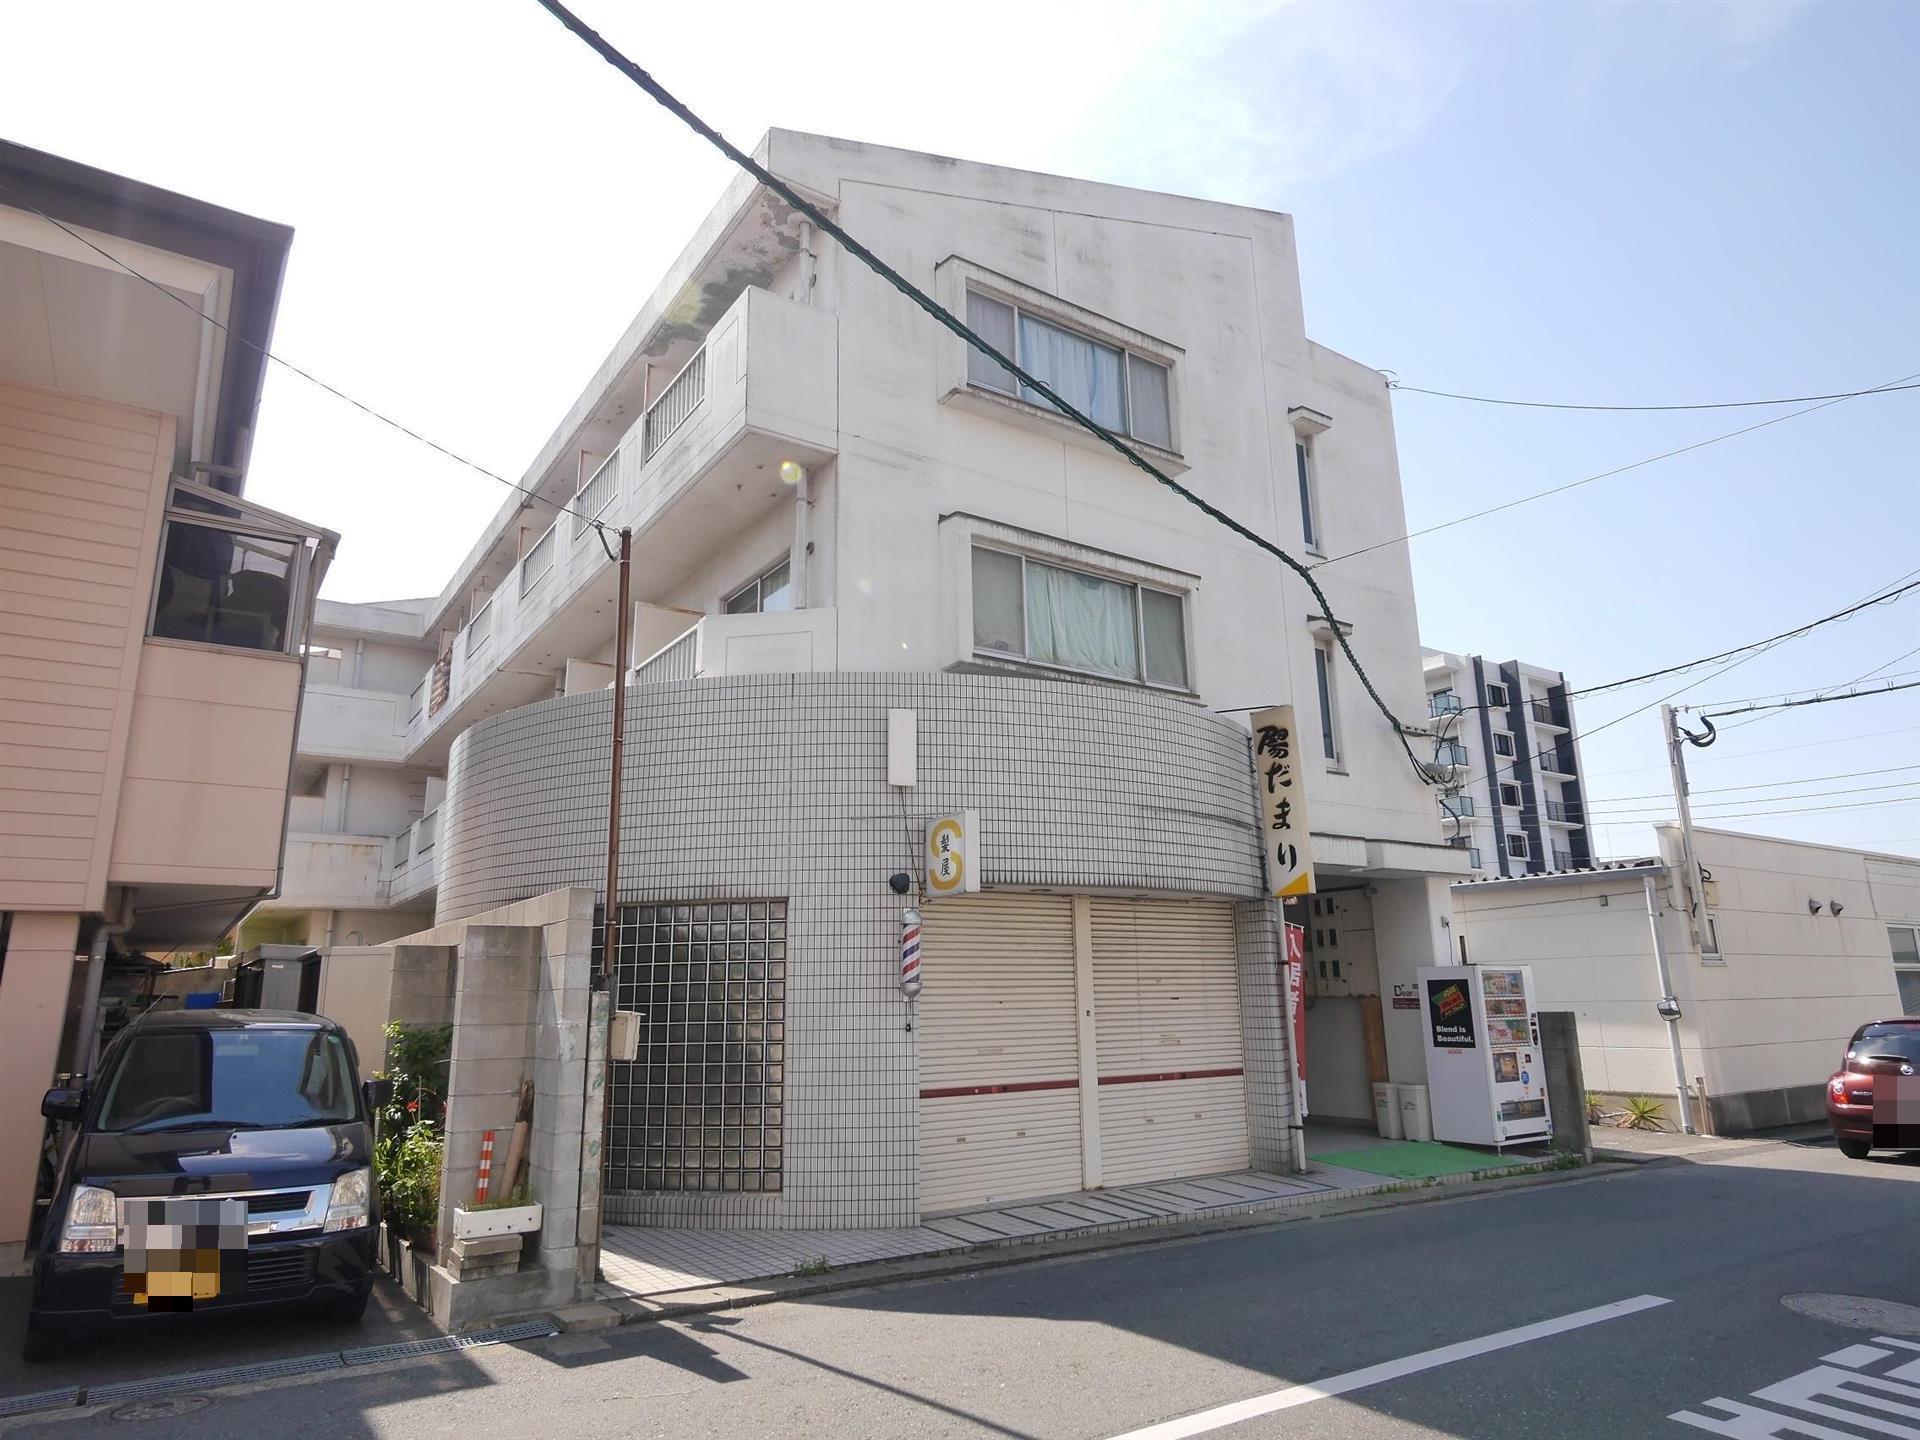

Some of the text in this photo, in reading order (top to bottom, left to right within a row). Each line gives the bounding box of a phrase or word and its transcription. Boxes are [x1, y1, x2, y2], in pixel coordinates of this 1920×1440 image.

[1256, 725, 1297, 873] 陽だまり
[1436, 1025, 1467, 1033] Blend is
[1437, 1034, 1474, 1043] Beautiful.
